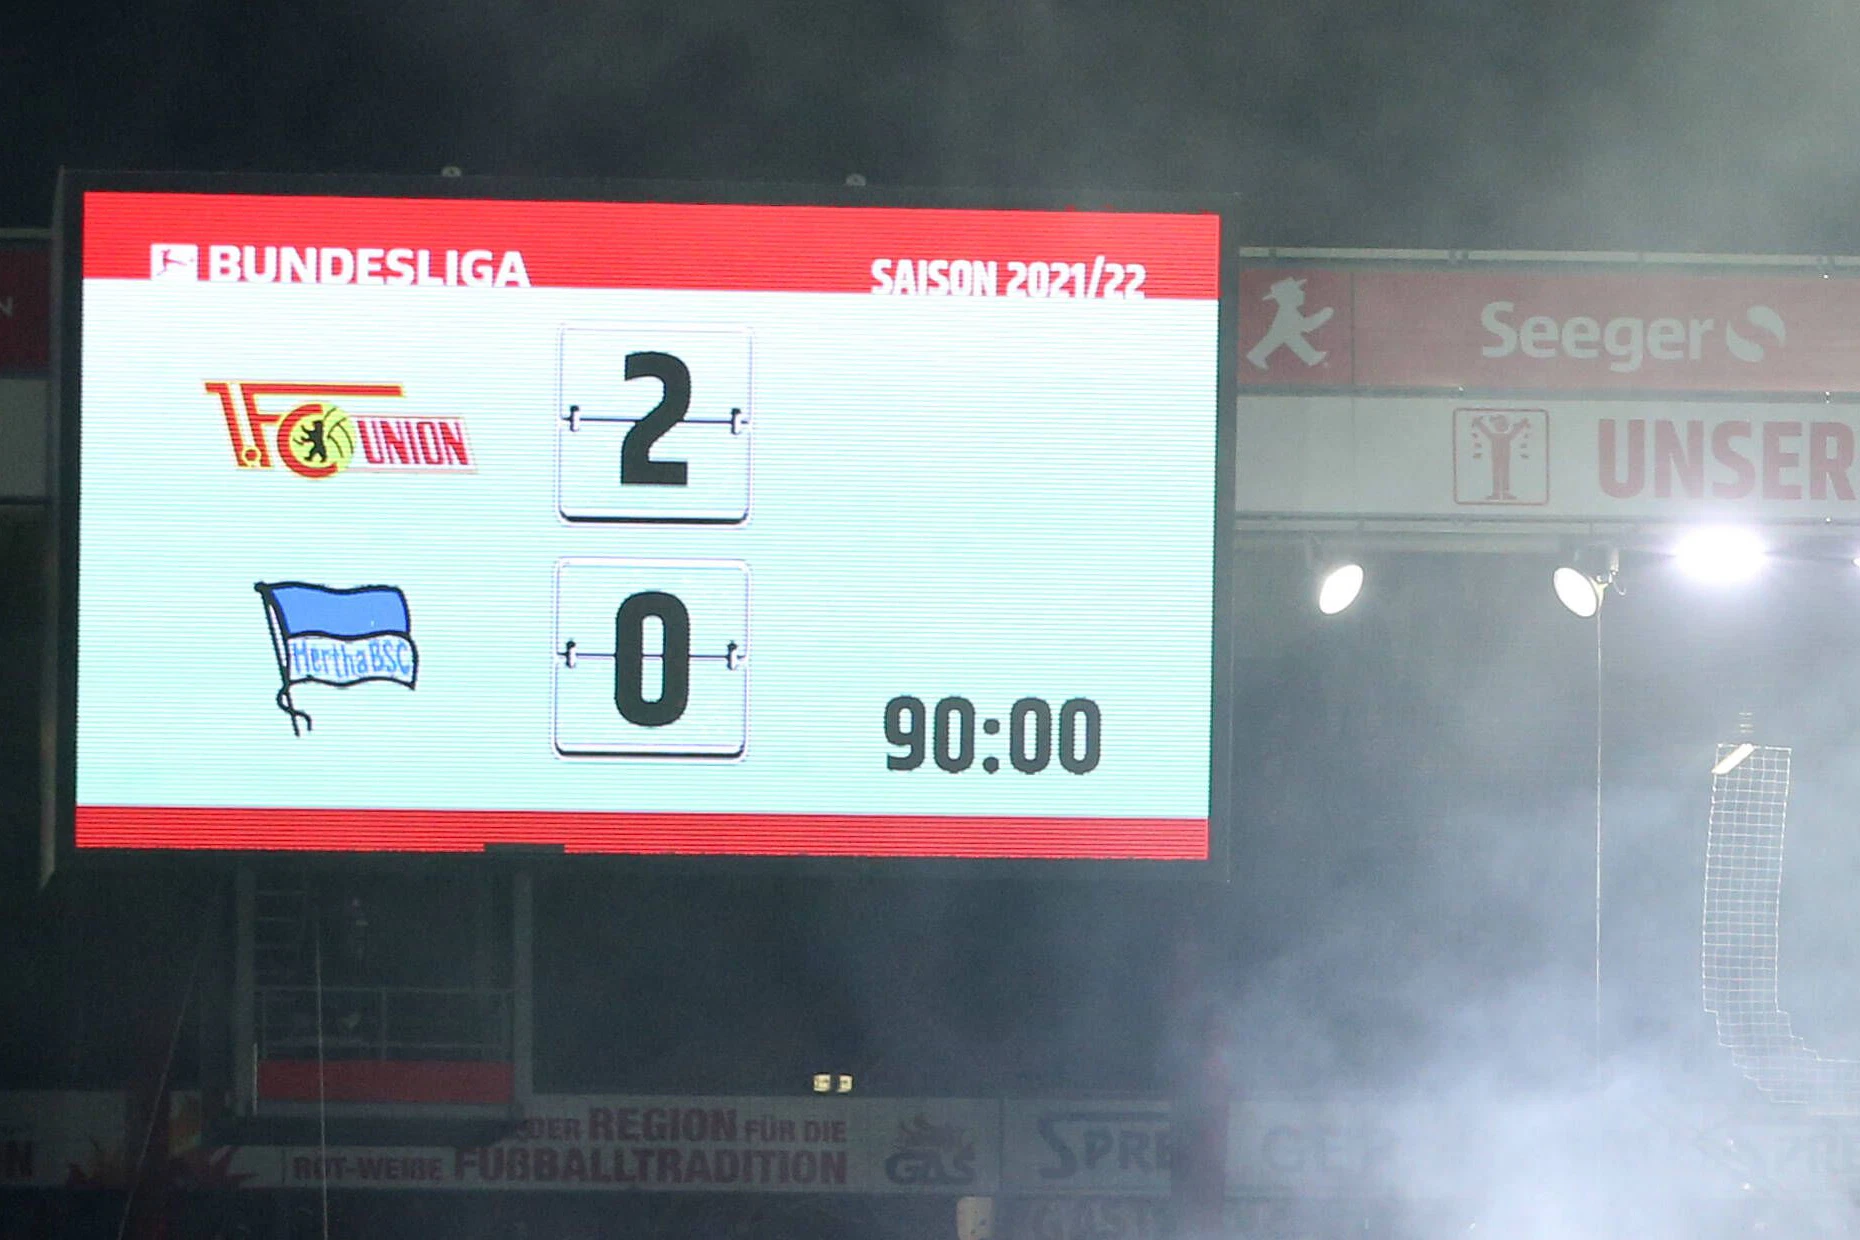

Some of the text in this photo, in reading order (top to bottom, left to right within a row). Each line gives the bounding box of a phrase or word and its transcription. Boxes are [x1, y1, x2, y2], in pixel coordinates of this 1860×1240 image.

[209, 244, 534, 288] BUNDESLIGA
[870, 254, 1148, 300] SAISON 2021/22
[1480, 301, 1714, 373] Seeger
[621, 351, 692, 486] 2
[291, 638, 412, 679] Hertha BSC
[614, 591, 690, 728] 0
[884, 695, 1101, 775] 90:00
[588, 1107, 738, 1142] REGION
[803, 1119, 848, 1143] DIE
